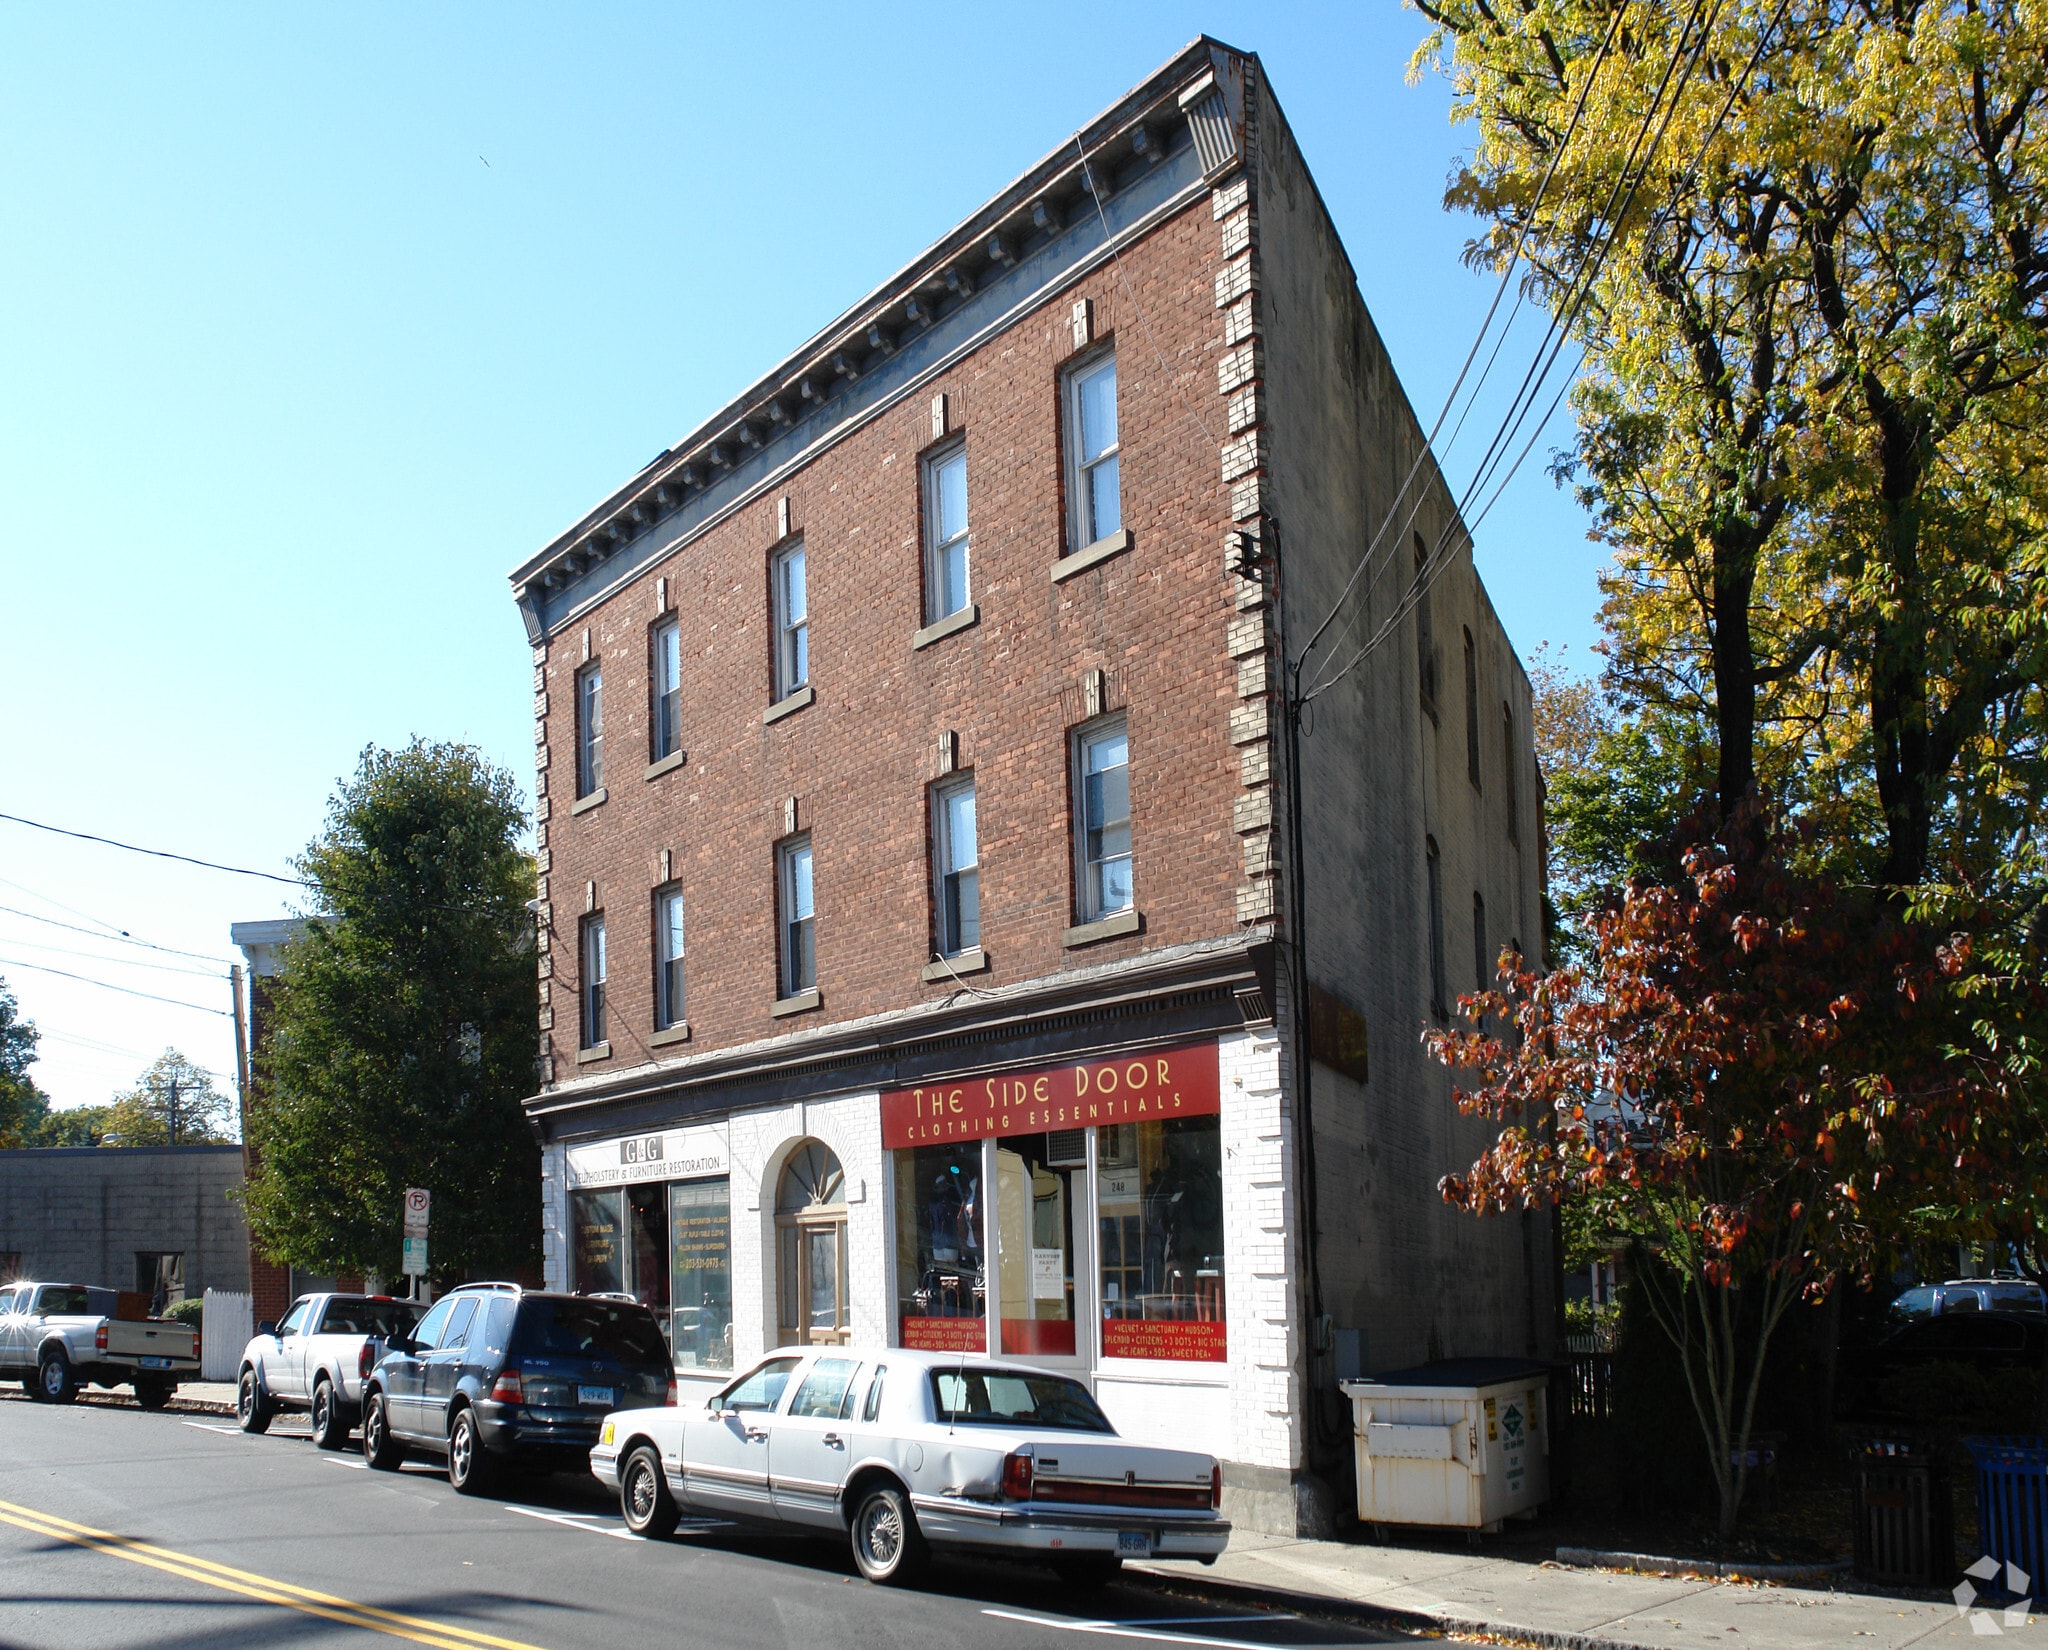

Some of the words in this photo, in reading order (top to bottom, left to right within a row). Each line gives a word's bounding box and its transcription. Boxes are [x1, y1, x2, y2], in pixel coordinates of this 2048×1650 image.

[913, 1089, 963, 1118] THE
[986, 1077, 1049, 1108] SIDE
[1076, 1059, 1170, 1097] DOOR
[908, 1115, 1009, 1139] CLOTHING
[1029, 1093, 1181, 1125] ESSENTIALS
[629, 1162, 667, 1178] FURNITURE
[669, 1156, 720, 1174] RESTORATION
[1111, 1181, 1125, 1193] 248
[1116, 1324, 1139, 1333] VELVET
[1144, 1324, 1179, 1334] SANCTUARY
[1184, 1325, 1211, 1335] HUDSON
[1104, 1334, 1131, 1344] SPLENDID
[1135, 1335, 1163, 1346] CITIZENS
[1174, 1336, 1192, 1347] DOTS
[1130, 1347, 1148, 1356] JEANS
[1171, 1348, 1193, 1358] SWEET
